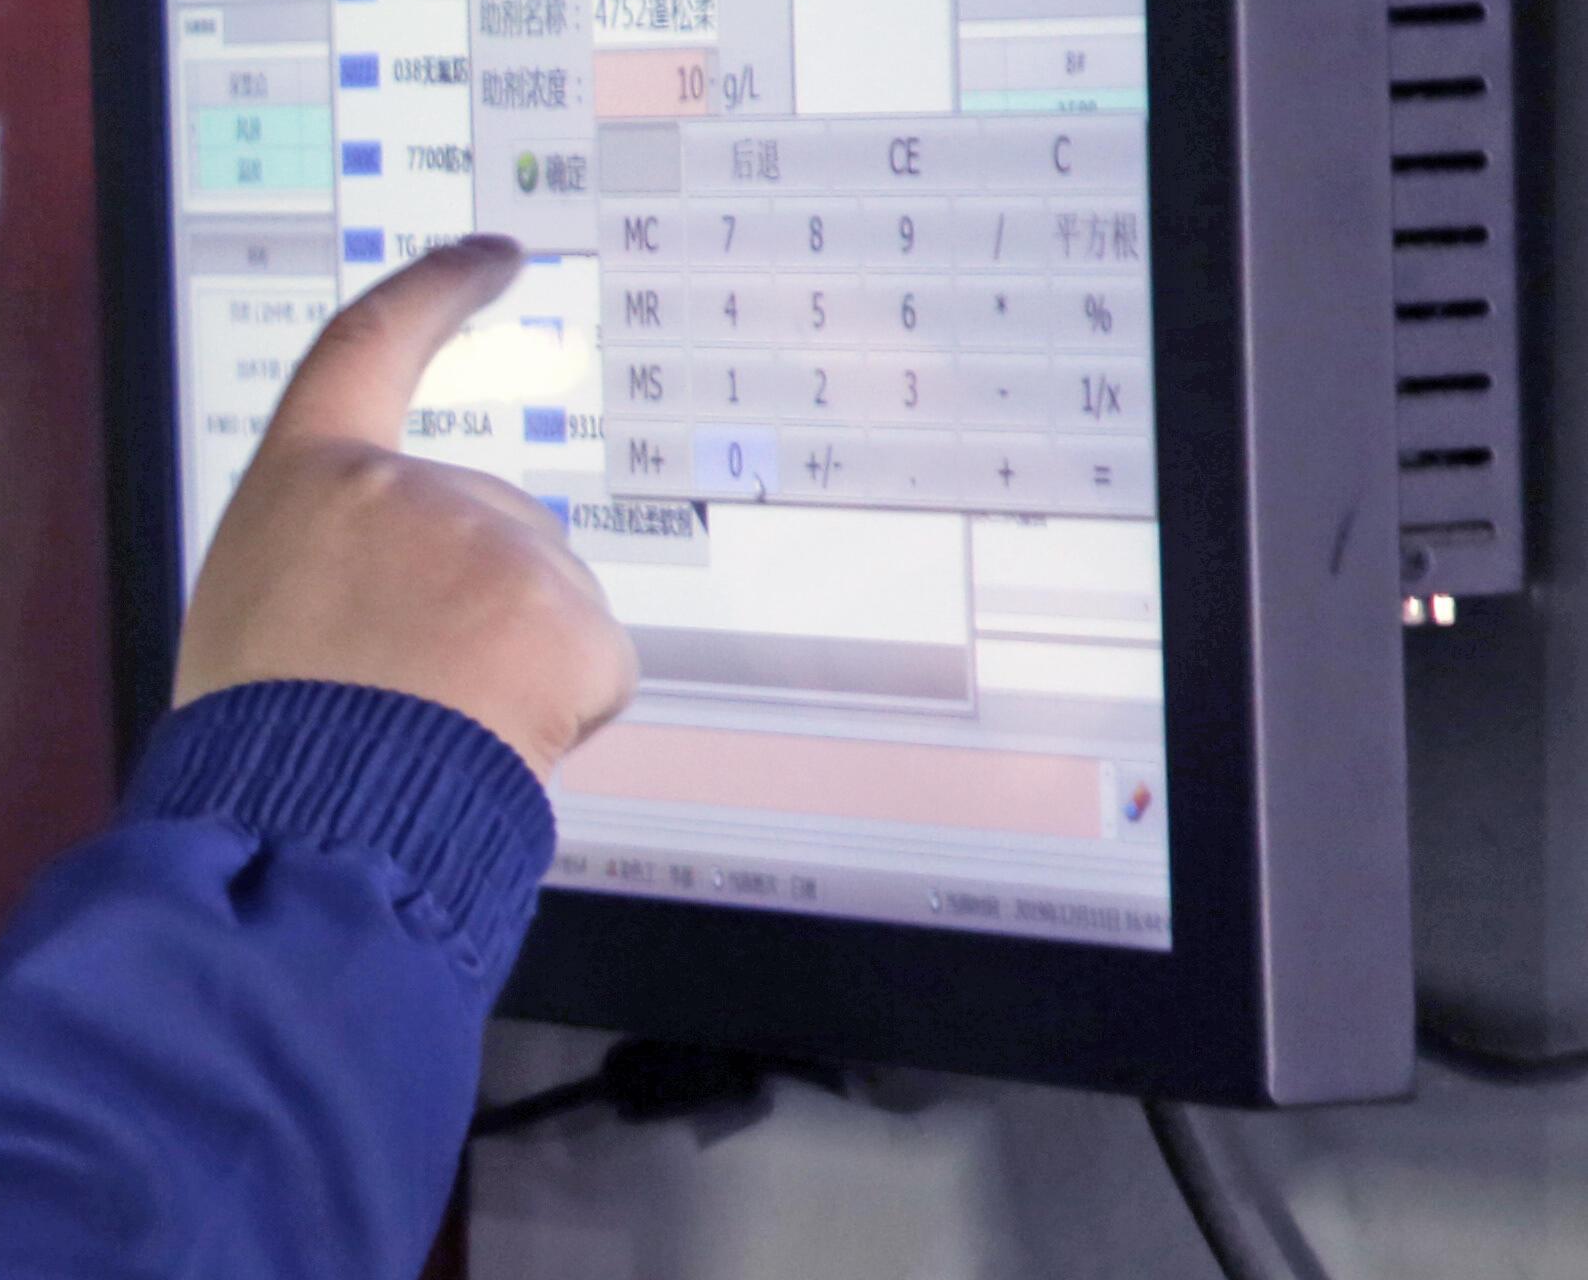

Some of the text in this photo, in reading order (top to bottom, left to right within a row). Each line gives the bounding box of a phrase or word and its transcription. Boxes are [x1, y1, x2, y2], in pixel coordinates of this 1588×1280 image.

[677, 64, 705, 102] 10
[723, 64, 760, 110] g/L
[544, 154, 587, 194] 确定
[732, 137, 782, 181] 后退
[889, 136, 921, 176] CE
[1053, 134, 1071, 176] C
[624, 215, 660, 254] MC
[722, 214, 736, 253] 7
[809, 214, 824, 253] 8
[899, 214, 915, 254] 9
[1054, 211, 1139, 261] 平方根
[624, 289, 661, 329] MR
[724, 291, 738, 328] 4
[812, 291, 826, 330] 5
[901, 292, 917, 331] 6
[1084, 293, 1113, 334] %
[628, 364, 664, 401] MS
[727, 367, 739, 404] 1
[813, 367, 828, 406] 2
[903, 369, 919, 409] 3
[1081, 373, 1122, 421] 1/x
[628, 438, 665, 475] M+
[728, 440, 744, 478] 0
